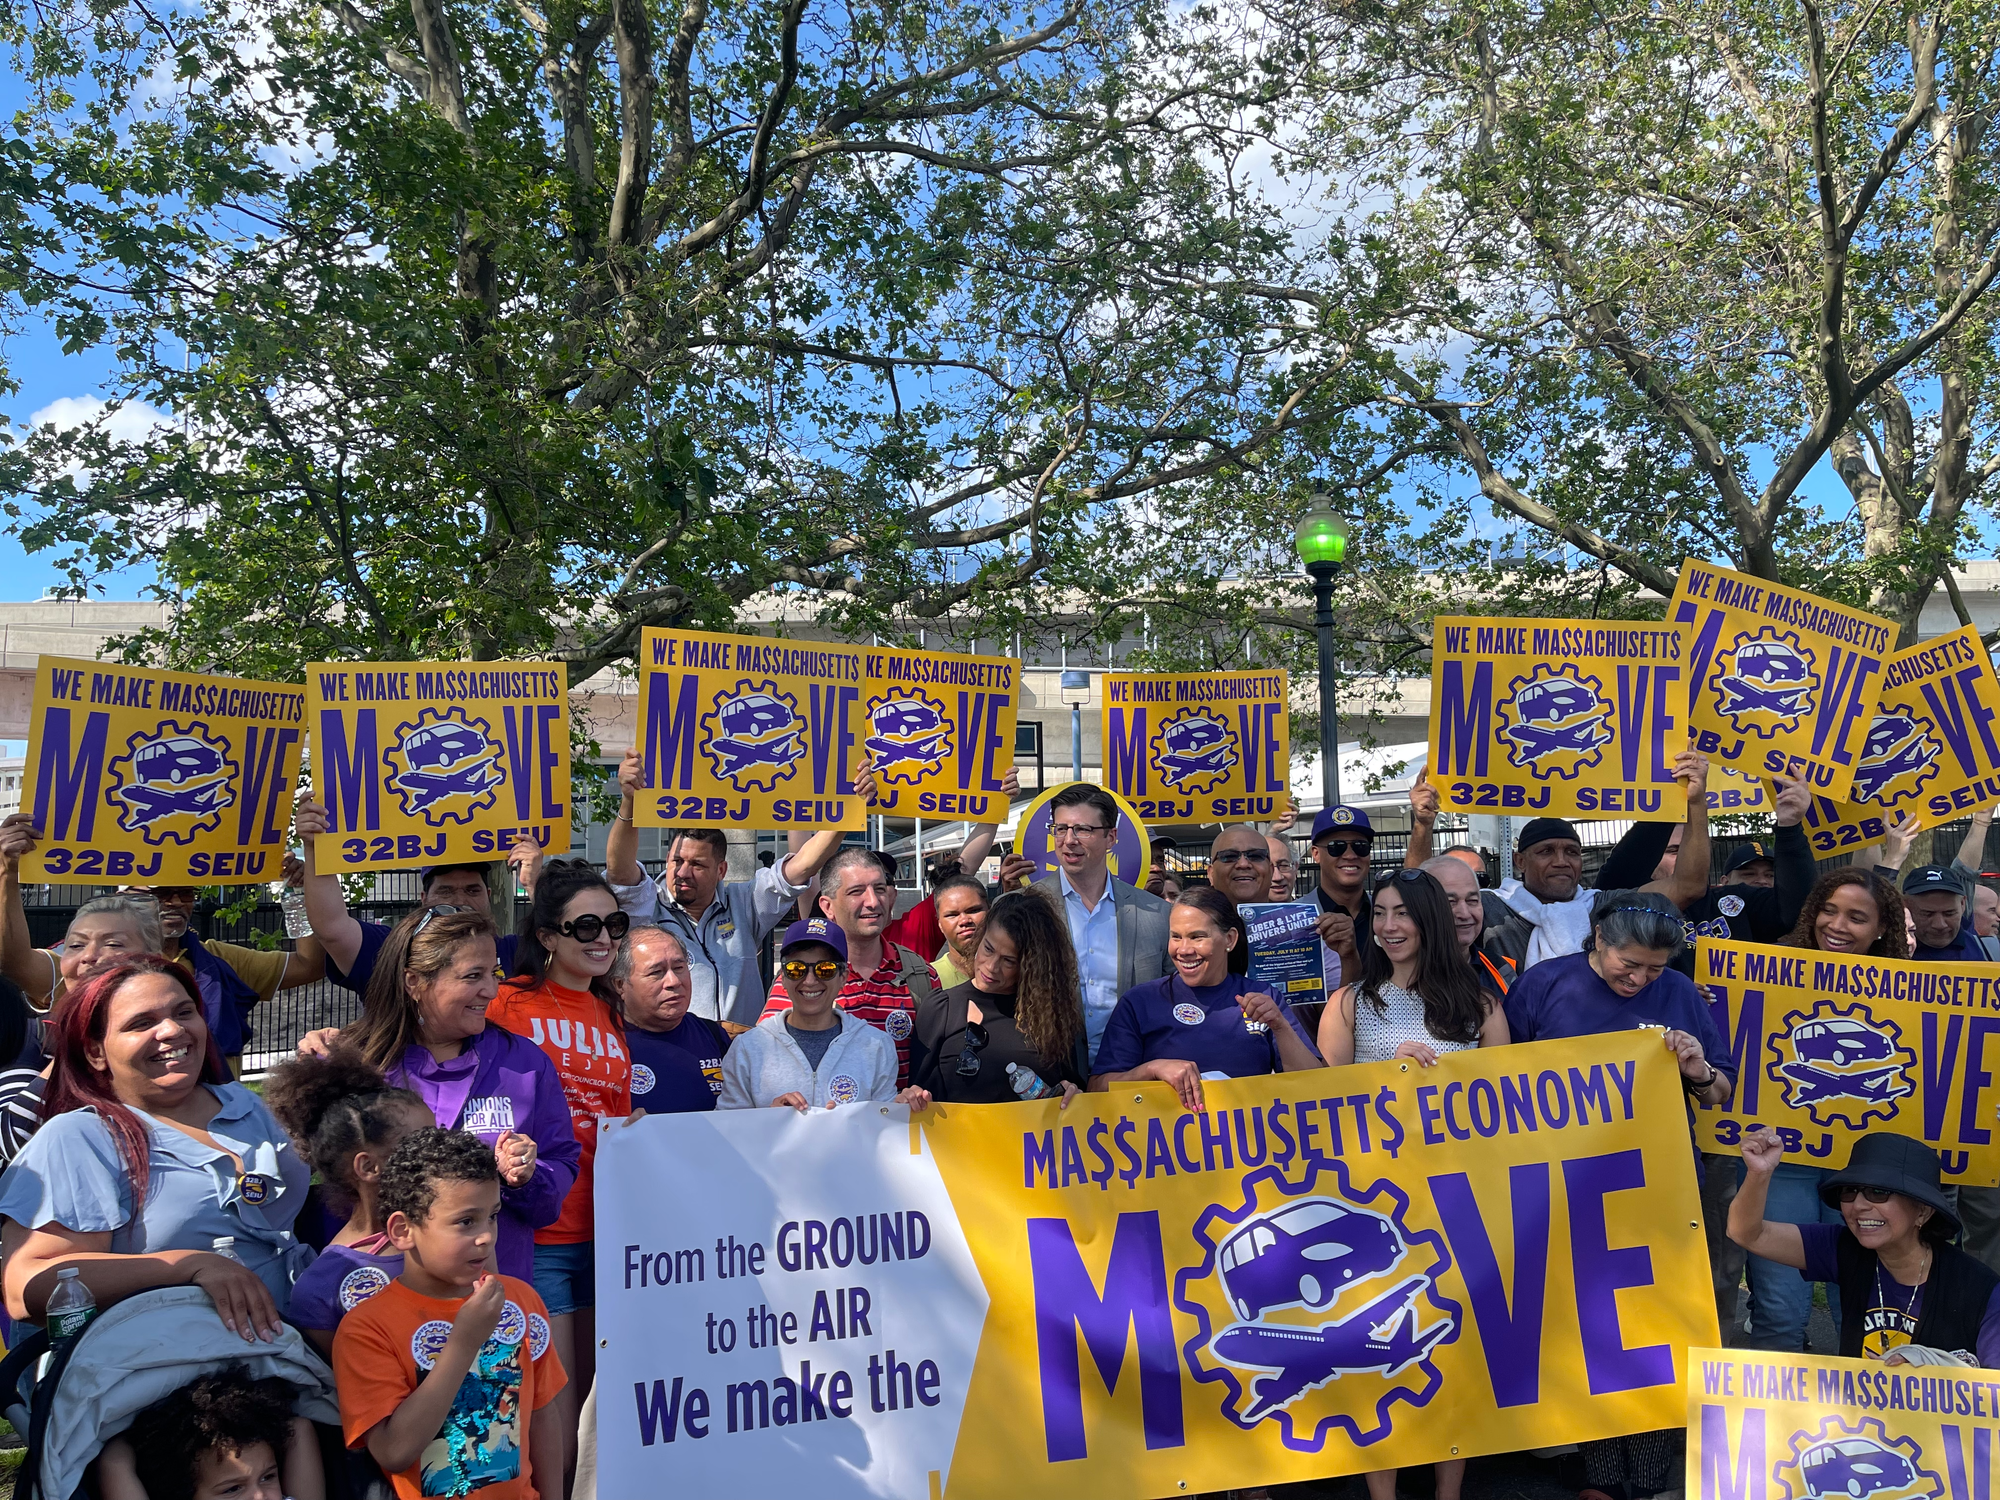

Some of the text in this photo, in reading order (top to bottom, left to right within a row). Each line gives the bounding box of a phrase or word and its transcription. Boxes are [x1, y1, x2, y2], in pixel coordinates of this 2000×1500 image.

[1688, 570, 1888, 654] WE MAKE MA$$ACHUSETT$
[1446, 627, 1680, 659] WE MAKE MA$$ACHUSETT$
[653, 638, 858, 681] WE MAKE MA$$ACHUSETT$
[867, 656, 1011, 689] KE MA$$ACHUSETT$
[1883, 635, 1975, 691] ACHUSETT$
[53, 669, 303, 721] WE MAKE MA$$ACHUSETT$
[320, 671, 558, 700] WE MAKE MA$$ACHUSETT$
[1110, 677, 1280, 701] WE MAKE MA$$ACHUSETT$
[1689, 725, 1745, 759] BJ
[657, 796, 749, 820] 32BJ
[773, 800, 843, 822] SEIU
[919, 793, 987, 814] SEIU
[1213, 798, 1272, 816] SEIU
[1451, 783, 1660, 812] 32BJ SEIU
[1706, 788, 1763, 808] 2BJ
[1928, 774, 2000, 816] SEIU
[45, 849, 264, 876] 32BJ SEIU
[343, 834, 446, 862] 32BJ
[1247, 926, 1286, 943] DRIVERS
[1251, 911, 1307, 933] UBER & LYFT
[1709, 949, 1736, 978] WE
[1746, 954, 1805, 987] MAKE
[527, 1018, 626, 1063] JULIA
[464, 1096, 511, 1112] UNIONS
[466, 1112, 513, 1128] FOR ALL
[1024, 1061, 1635, 1190] MA$$ACHU$ETT$ ECONOMY
[1716, 1120, 1832, 1157] 3BJ
[625, 1211, 930, 1289] From the GROUND
[60, 1312, 86, 1328] Poland
[706, 1287, 872, 1354] to the AIR
[634, 1350, 940, 1446] We make the
[1704, 1363, 2000, 1419] WE MAKE MA$$ACHUSET
